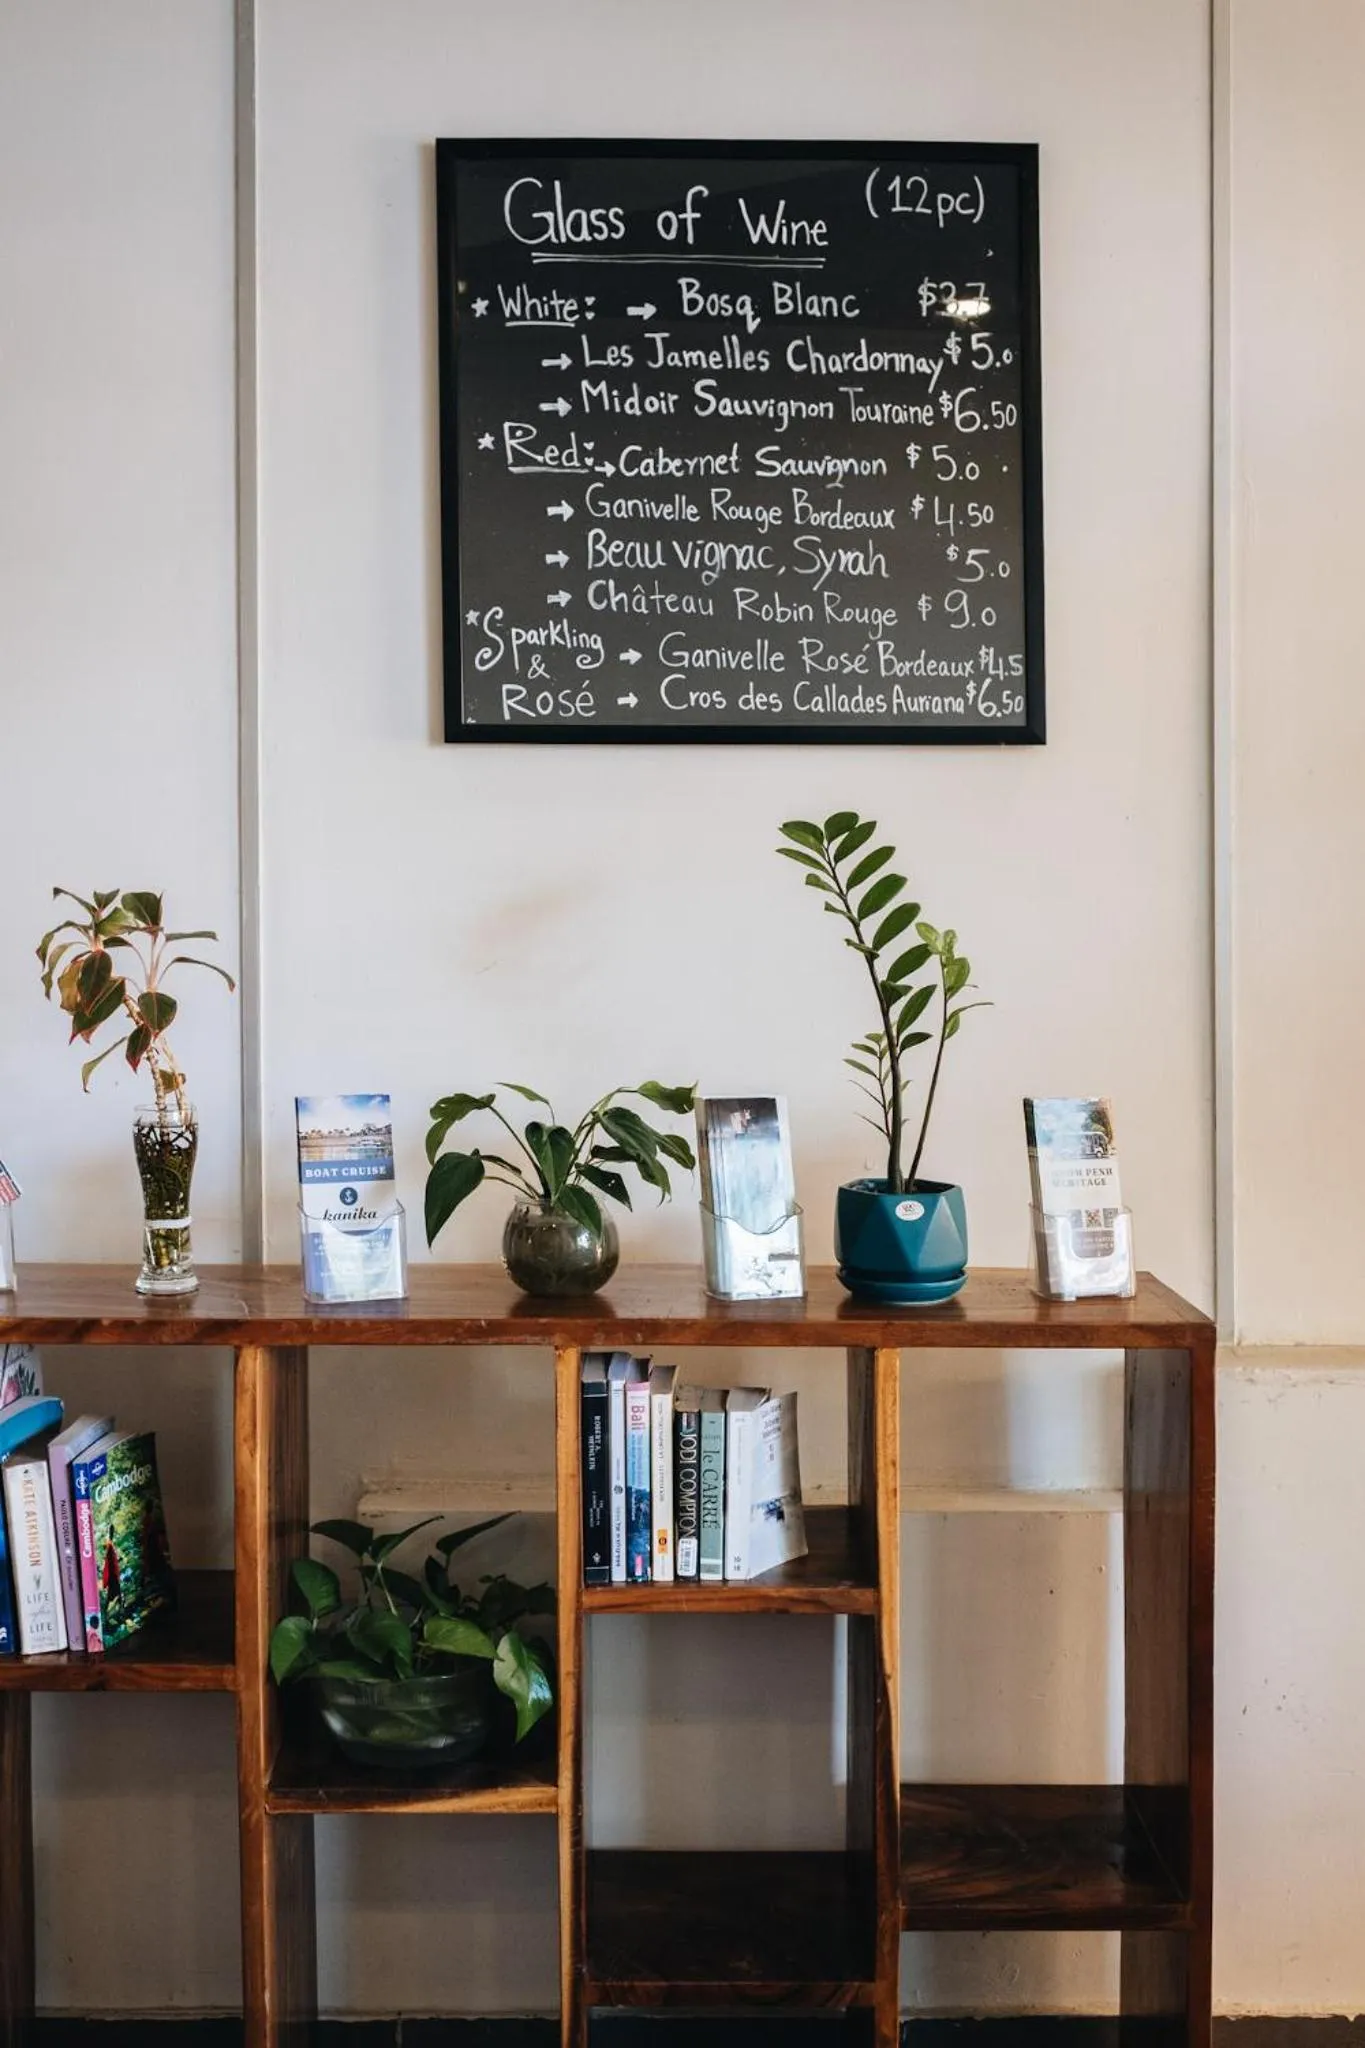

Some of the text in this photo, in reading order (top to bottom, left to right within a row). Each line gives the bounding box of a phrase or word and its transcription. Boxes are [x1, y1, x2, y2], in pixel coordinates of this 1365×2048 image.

[504, 177, 828, 246] Glass of Wine
[866, 168, 984, 228] (12pc)
[678, 277, 760, 334] Bosq
[773, 282, 860, 317] Blanc
[581, 334, 634, 367] Les
[644, 333, 769, 371] Jamelles
[787, 336, 943, 393] Chardonnay
[581, 380, 678, 416] Midoir
[694, 379, 833, 432] Sauvignon
[839, 387, 934, 426] Touraine
[619, 442, 739, 477] Cabernet
[755, 446, 887, 488] Sauvignon
[586, 482, 700, 522] Ganivelle
[711, 488, 782, 533] Rouge
[792, 488, 895, 530] Bordeaux
[794, 536, 888, 591] Syrah
[588, 579, 713, 615] Château
[733, 588, 813, 622] Robin
[824, 591, 897, 639] Rouge
[475, 606, 604, 679] Sparkling
[659, 632, 784, 672] Ganivelle
[798, 637, 869, 673] Rosé
[877, 641, 974, 677] Bordeaux
[528, 654, 550, 679] &
[502, 680, 596, 720] Rosé
[660, 674, 726, 709] Cros
[739, 682, 782, 712] des
[794, 681, 887, 713] Callades
[305, 1165, 386, 1178] BOAT CRUISE
[323, 1206, 378, 1221] kanika
[631, 1405, 645, 1431] Bali
[679, 1432, 697, 1463] JODI
[703, 1449, 720, 1463] le
[94, 1463, 153, 1504] Cambodge
[679, 1468, 697, 1540] COMPTON
[21, 1478, 43, 1567] KATE ATKINSON
[80, 1502, 92, 1558] Cambodge
[27, 1592, 49, 1604] LIFE
[30, 1622, 53, 1634] LIFE
